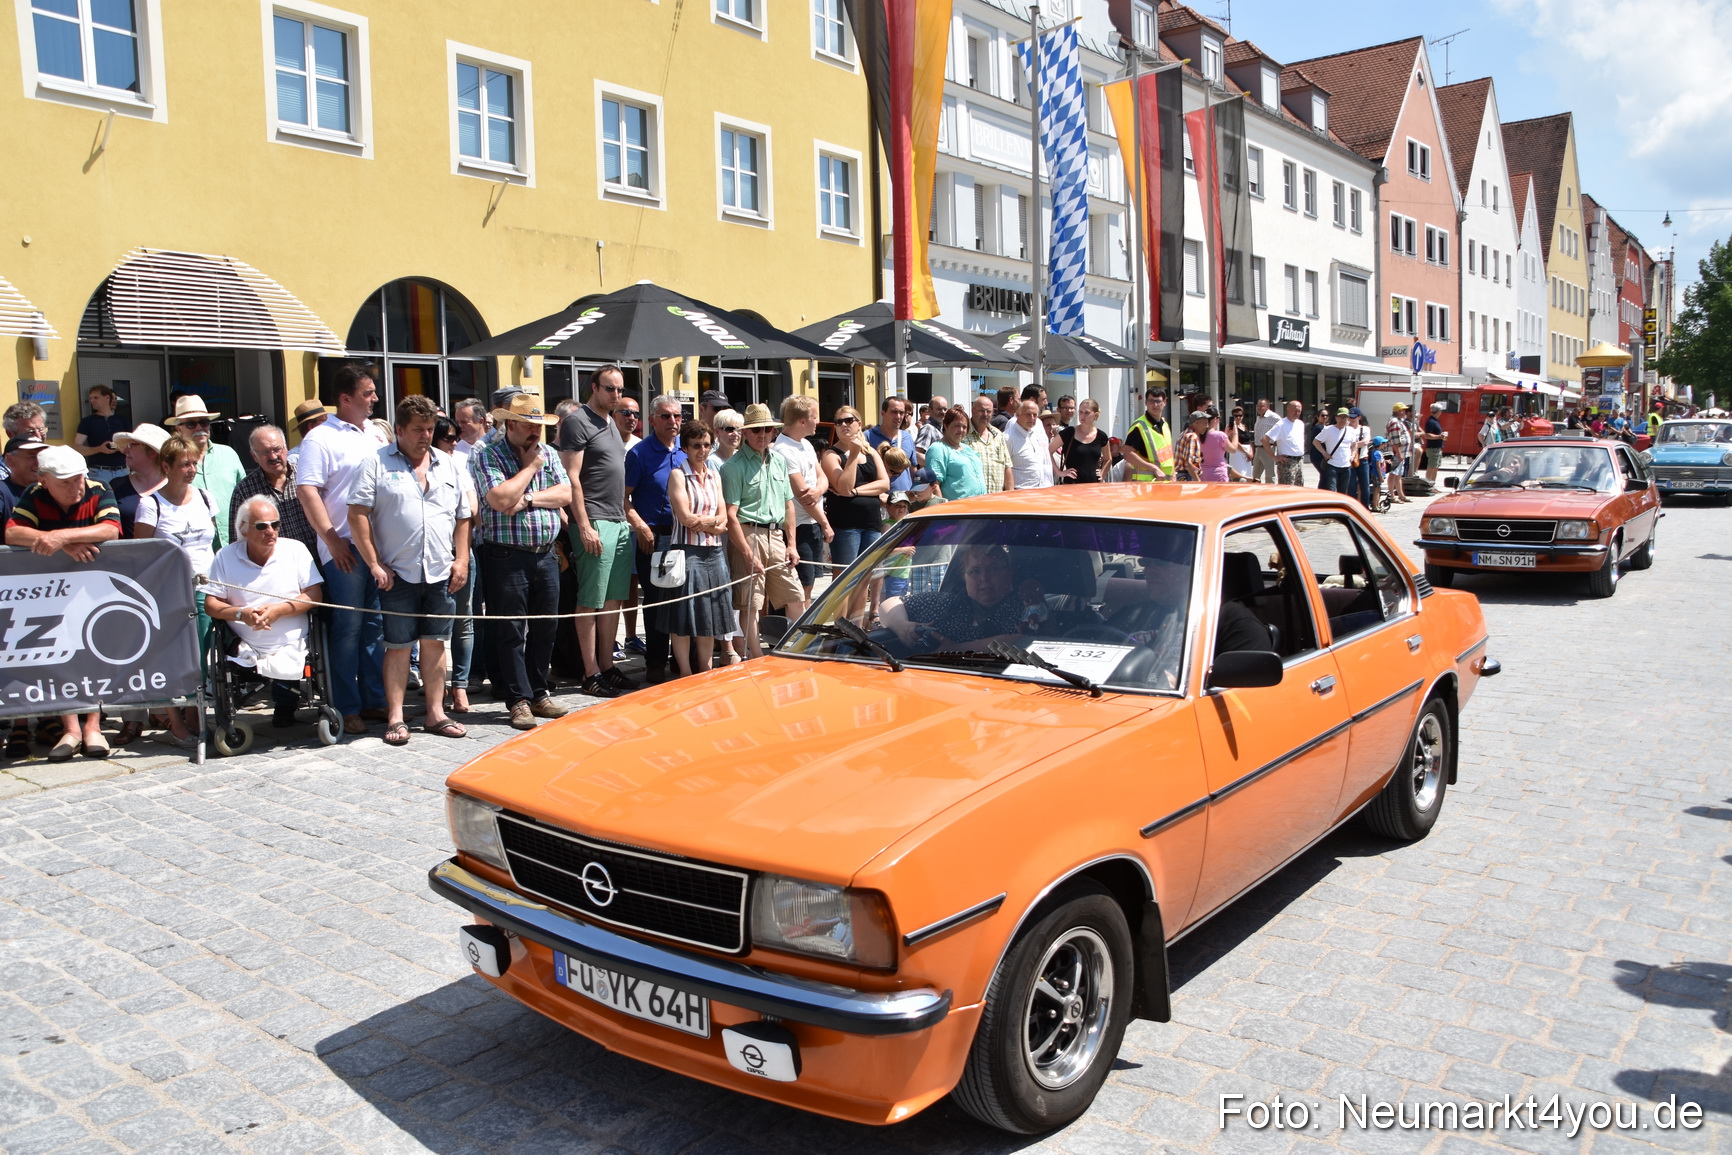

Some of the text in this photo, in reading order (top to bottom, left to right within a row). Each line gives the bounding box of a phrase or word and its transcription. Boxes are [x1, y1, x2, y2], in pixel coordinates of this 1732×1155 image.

[975, 126, 1025, 159] BRILLEN
[970, 284, 1031, 316] BRILLEN
[866, 375, 875, 386] 24
[1478, 555, 1535, 566] NM SN 91H
[1069, 649, 1106, 659] 332
[606, 969, 642, 1012] YK
[648, 983, 704, 1031] 64H
[746, 1066, 768, 1077] OPEL
